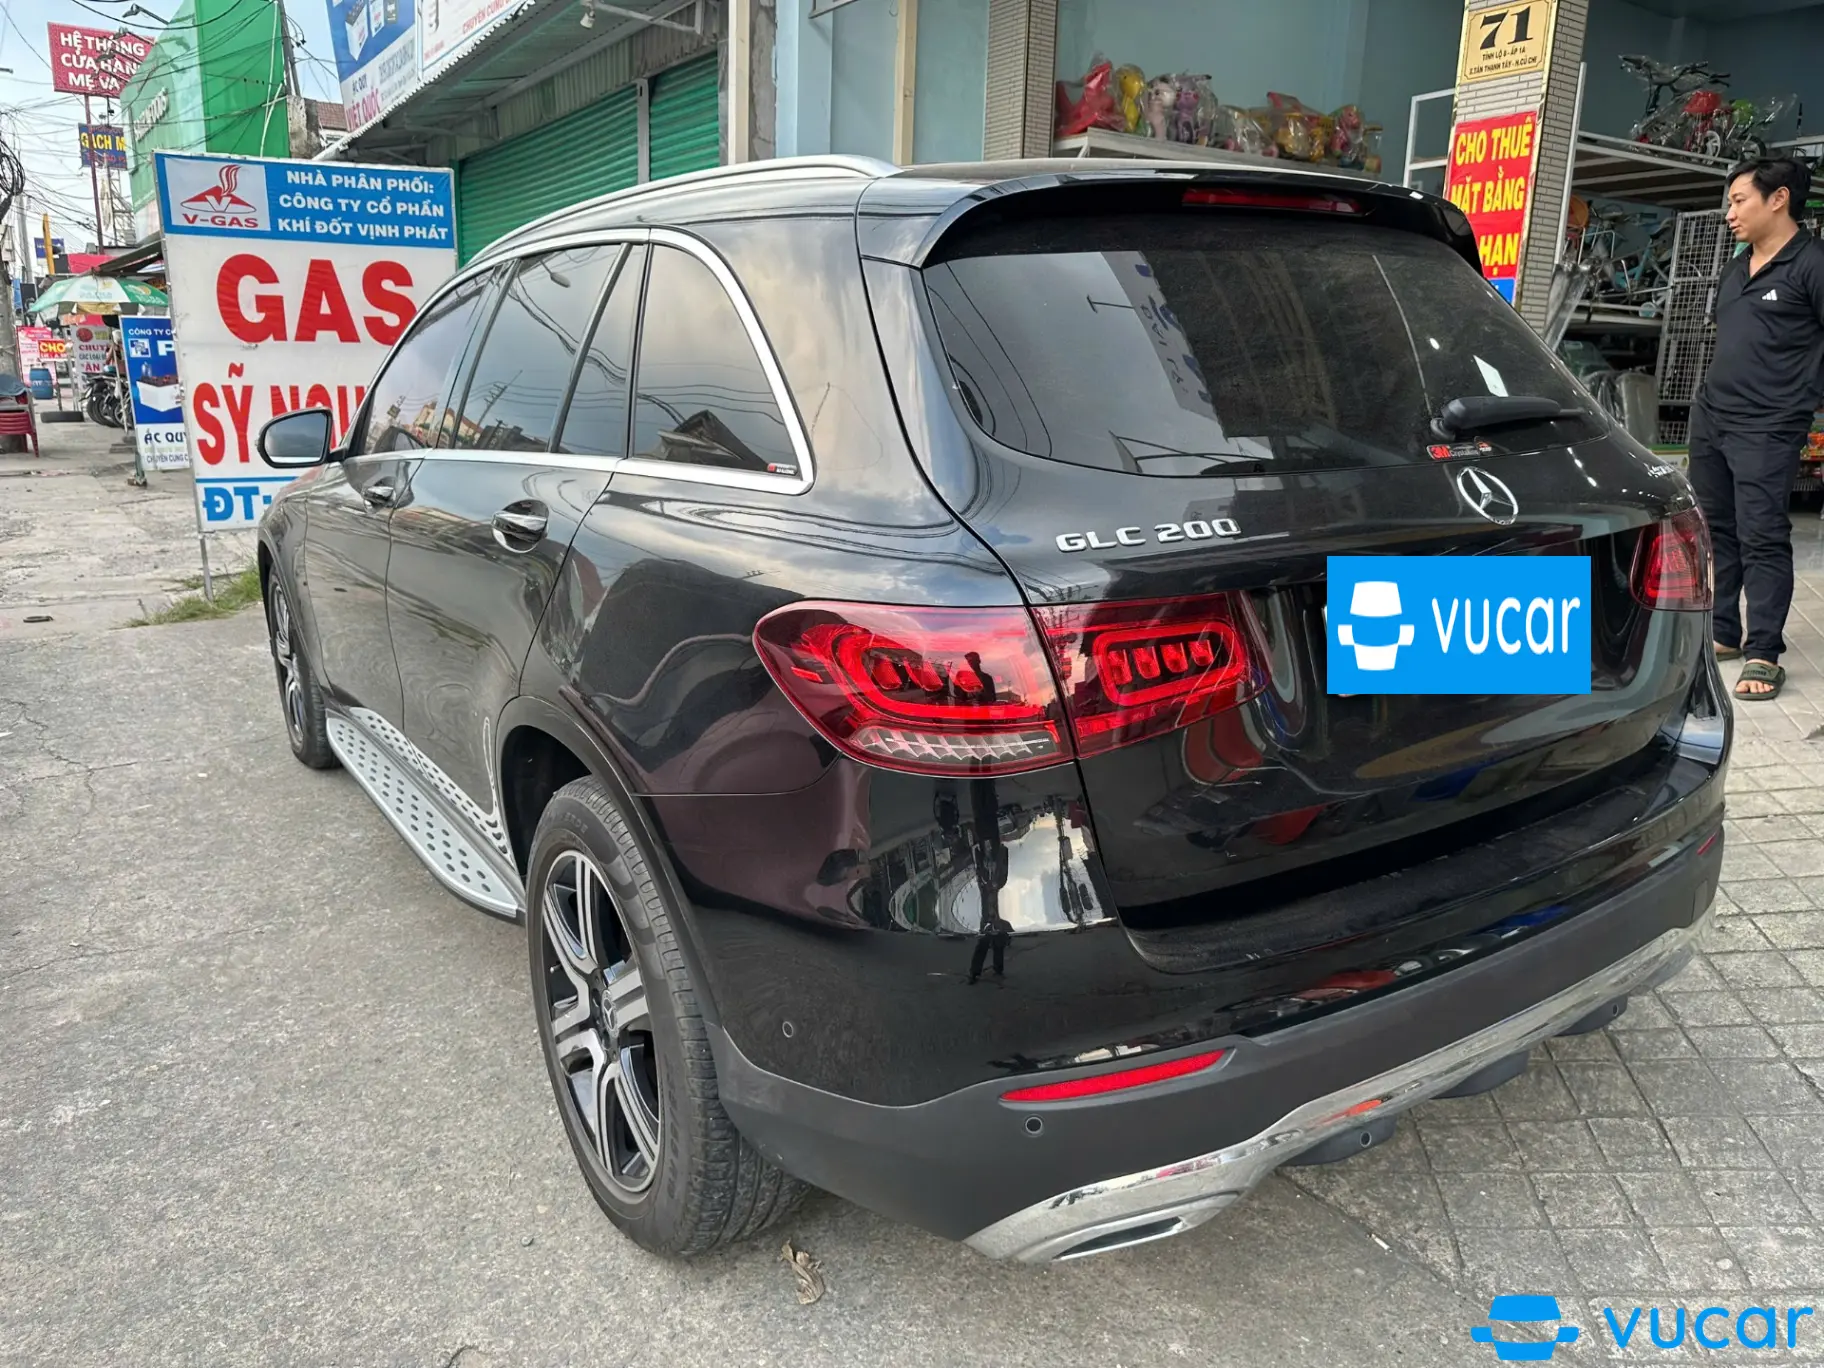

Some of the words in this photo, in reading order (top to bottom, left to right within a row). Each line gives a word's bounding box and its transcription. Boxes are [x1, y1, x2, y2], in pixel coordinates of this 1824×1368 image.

[1480, 5, 1533, 50] 71
[1454, 129, 1487, 167] CHO
[1491, 115, 1533, 161] THUÊ
[286, 169, 328, 187] NHÀ
[331, 172, 382, 191] PHÂN
[386, 175, 435, 194] PHỐI:
[1482, 166, 1526, 214] BẰNG
[279, 191, 334, 212] CÔNG
[337, 198, 362, 213] TY
[366, 195, 392, 215] CỔ
[396, 198, 445, 217] PHẦN
[182, 212, 259, 228] V-GAS
[277, 216, 312, 233] KHÍ
[314, 216, 354, 236] ĐỐT
[357, 223, 400, 240] VỊNH
[404, 223, 449, 240] PHÁT
[1479, 233, 1520, 276] HẠN
[216, 252, 418, 347] GAS
[128, 327, 152, 336] CÔNG
[153, 328, 164, 336] TY
[40, 342, 66, 353] CHO
[193, 362, 254, 466] SỸ
[1430, 444, 1450, 460] 3M
[1055, 526, 1147, 552] GLC
[1154, 517, 1242, 543] 200
